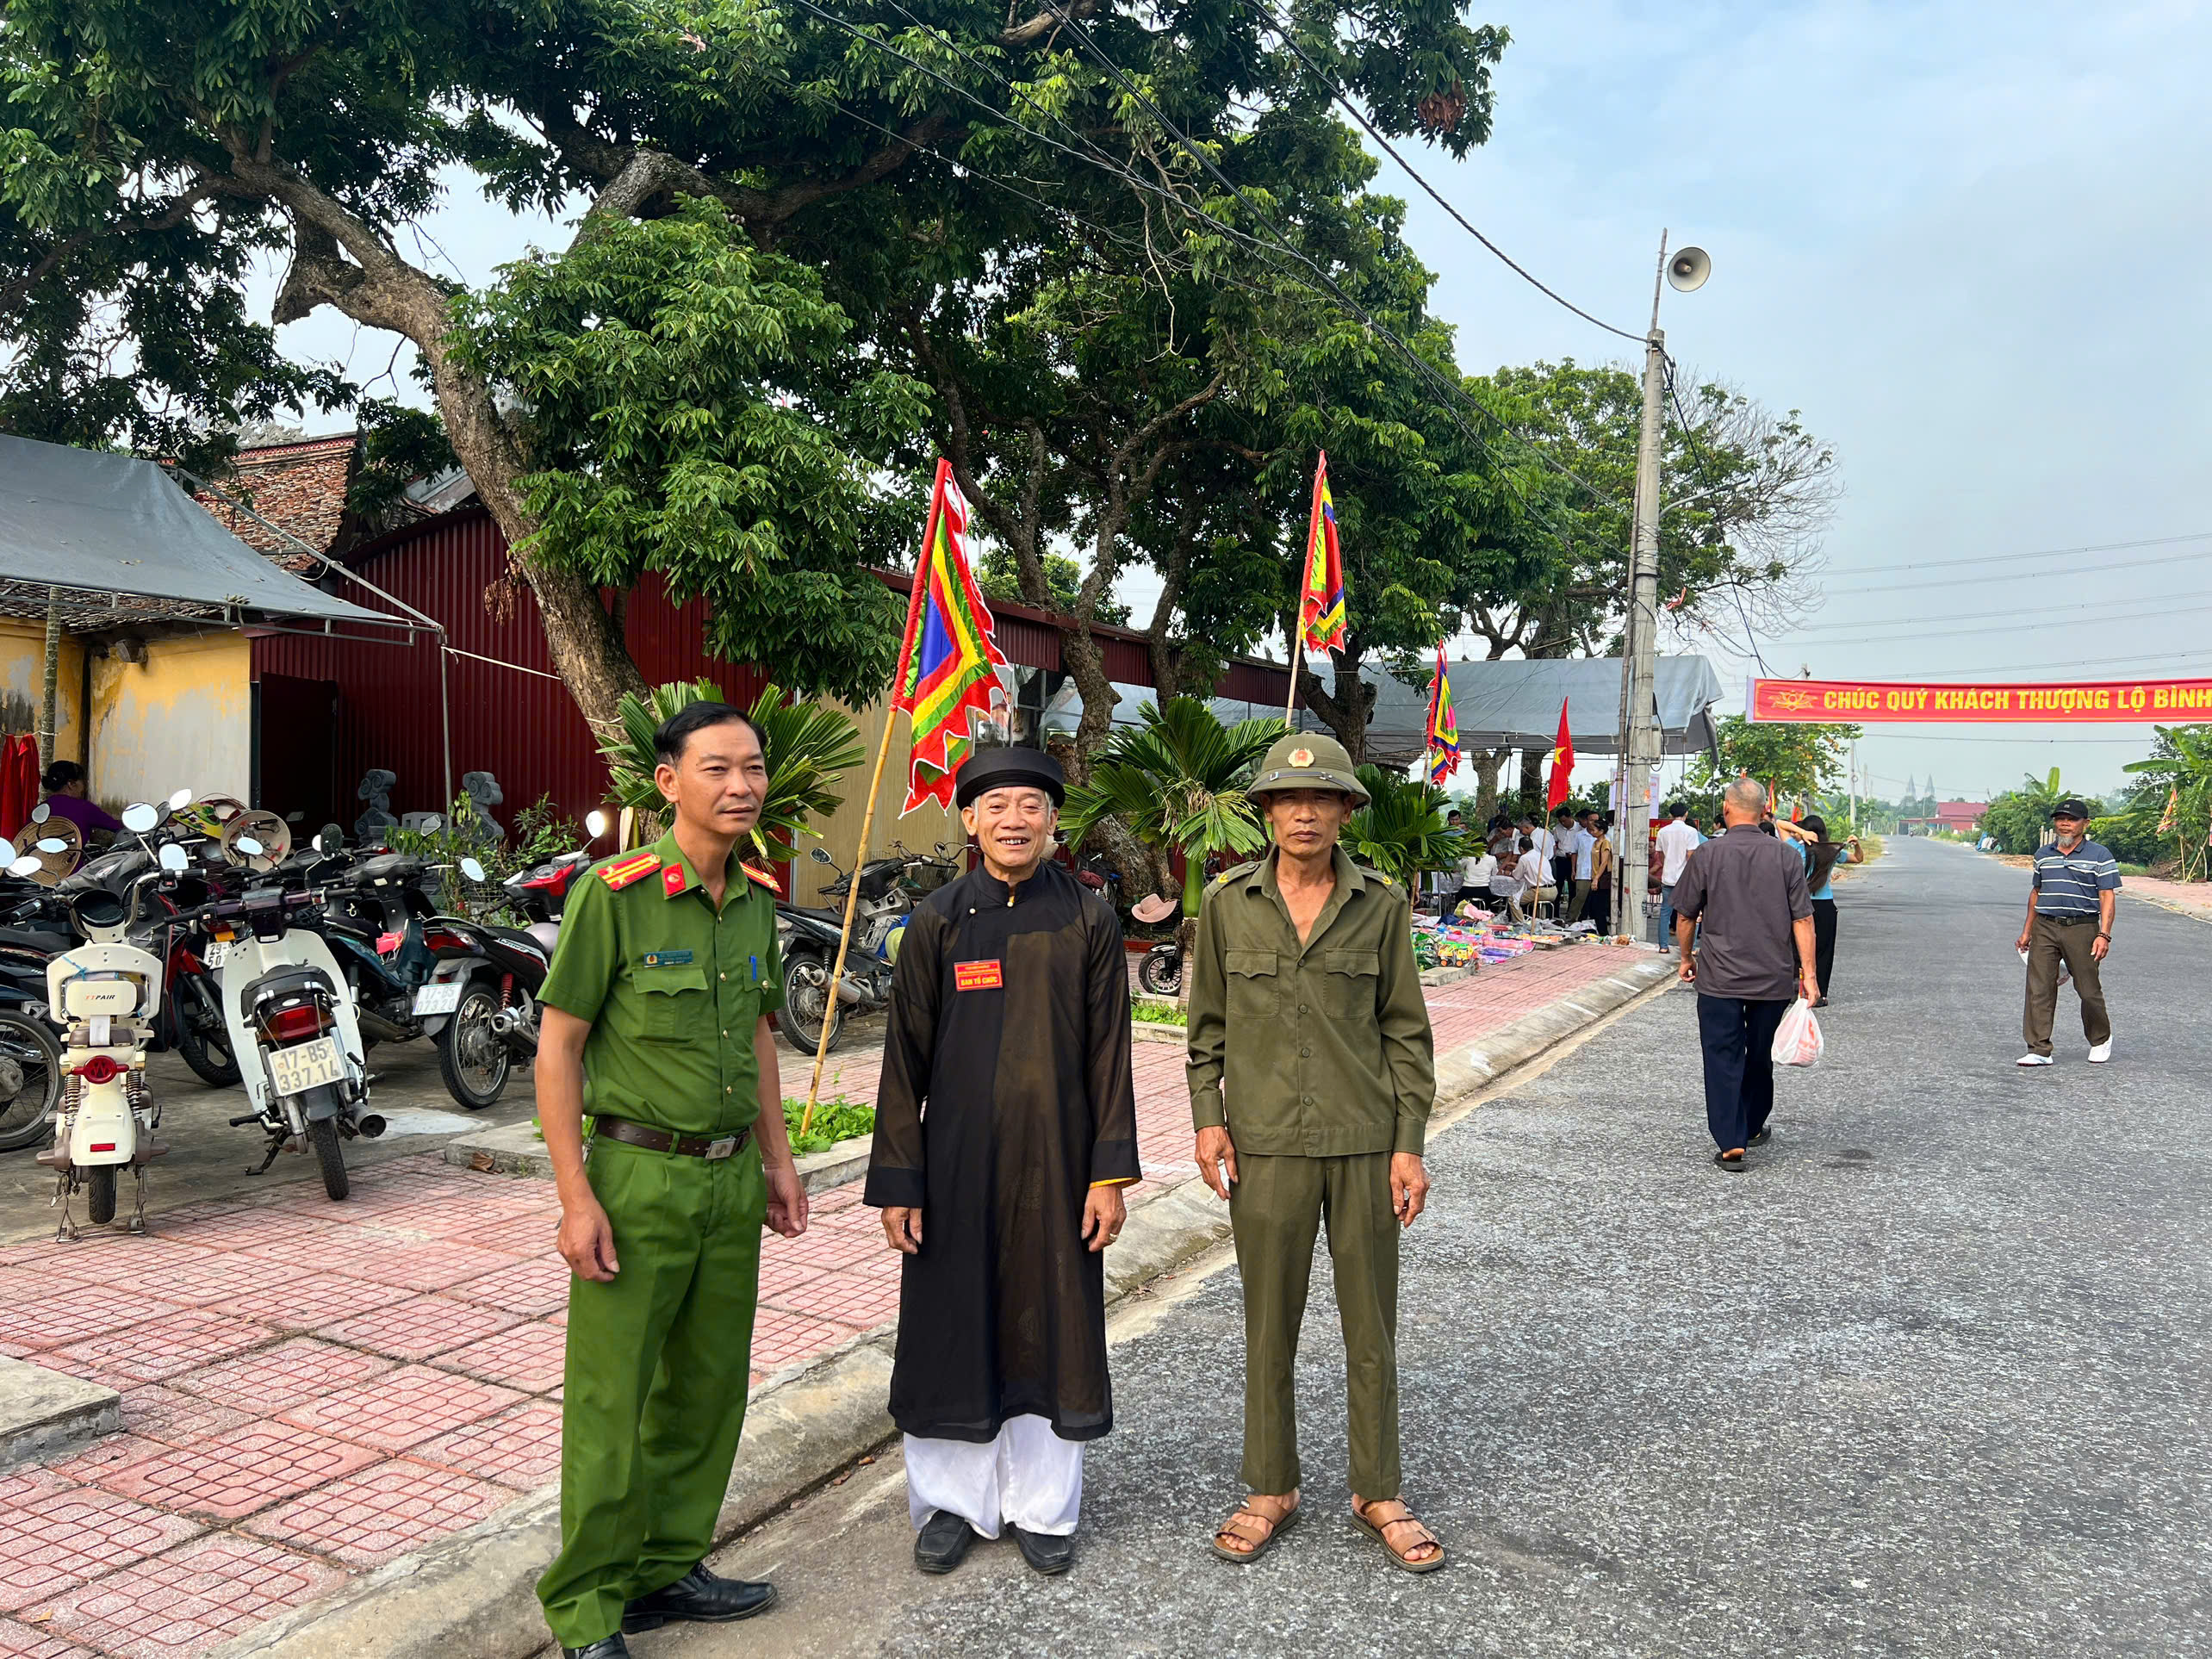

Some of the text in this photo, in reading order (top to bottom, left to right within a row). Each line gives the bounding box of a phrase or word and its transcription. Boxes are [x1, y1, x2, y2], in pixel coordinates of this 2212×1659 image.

[1824, 685, 2212, 713] CHÚC QUÝ KHÁCH THƯỢNG LỘ BÌNH
[280, 1041, 329, 1071] 17-B5
[279, 1060, 339, 1091] 337.14
